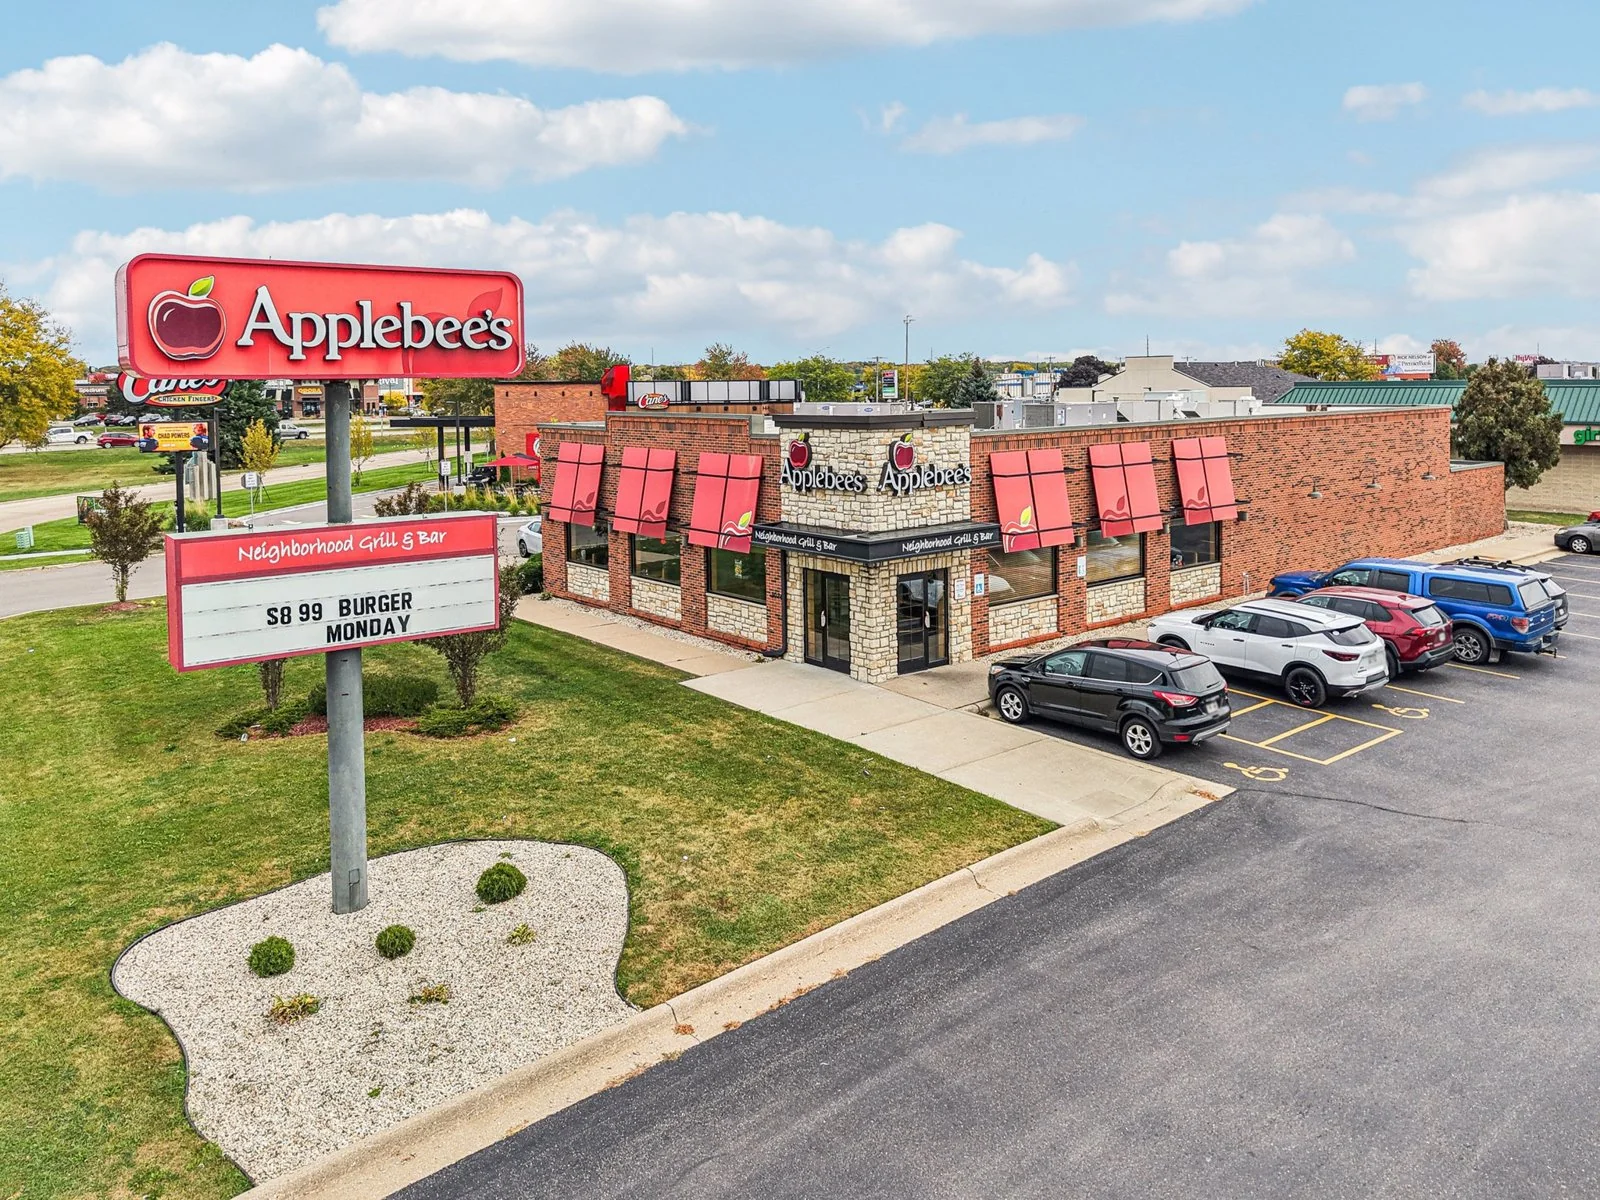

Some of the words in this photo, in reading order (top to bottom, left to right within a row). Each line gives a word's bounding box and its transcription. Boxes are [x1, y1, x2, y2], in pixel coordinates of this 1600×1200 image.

[237, 285, 514, 361] Applebee's
[779, 458, 864, 493] Applebee's
[880, 462, 972, 496] Applebee's
[238, 533, 354, 564] Neighborhood
[359, 531, 399, 550] Grill
[418, 530, 448, 546] Bar
[754, 531, 797, 546] Neighborhood
[798, 536, 815, 548] Grill
[823, 541, 838, 552] Bar
[902, 537, 952, 553] Neighborhood
[953, 533, 972, 546] Grill
[980, 531, 994, 542] Bar
[299, 603, 323, 622] 99
[338, 592, 413, 618] BURGER
[326, 614, 411, 643] MONDAY
